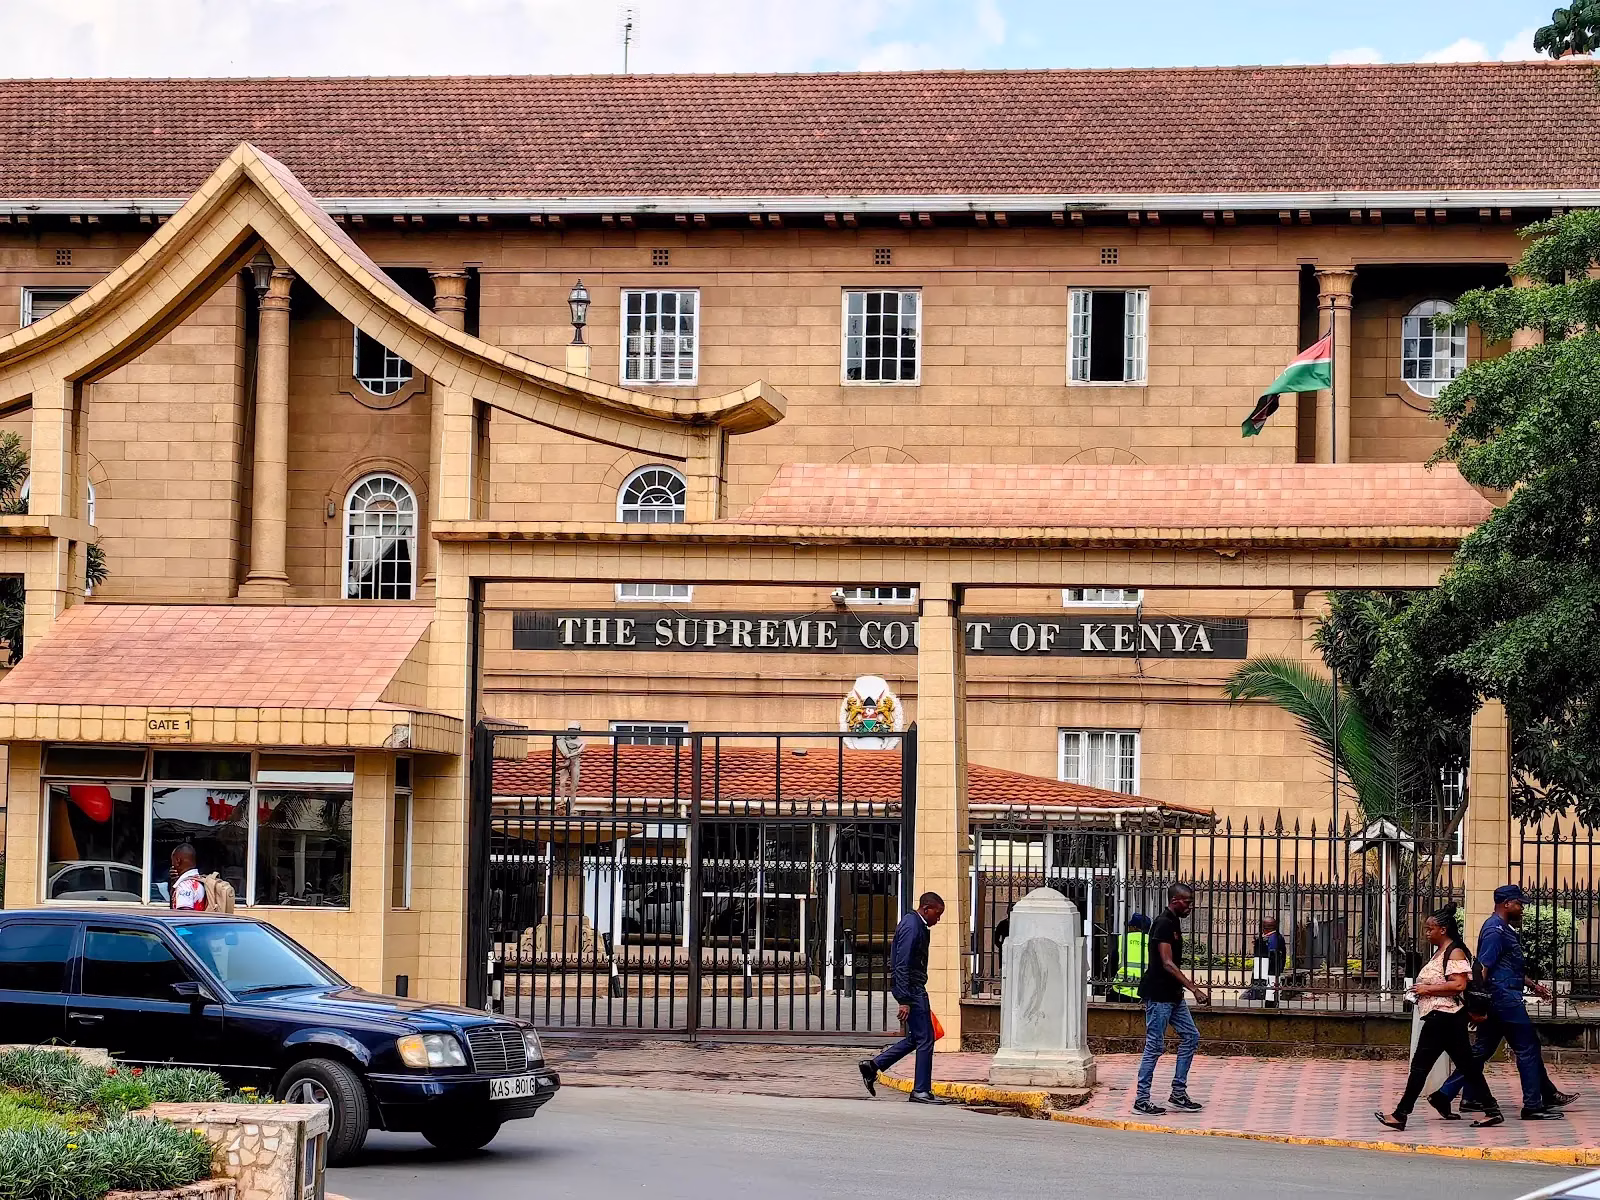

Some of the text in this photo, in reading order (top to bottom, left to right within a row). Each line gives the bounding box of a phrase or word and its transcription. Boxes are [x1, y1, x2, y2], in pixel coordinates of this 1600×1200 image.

[557, 617, 1215, 653] THE SUPREME COT OF KENYA
[148, 719, 191, 730] GATE 1
